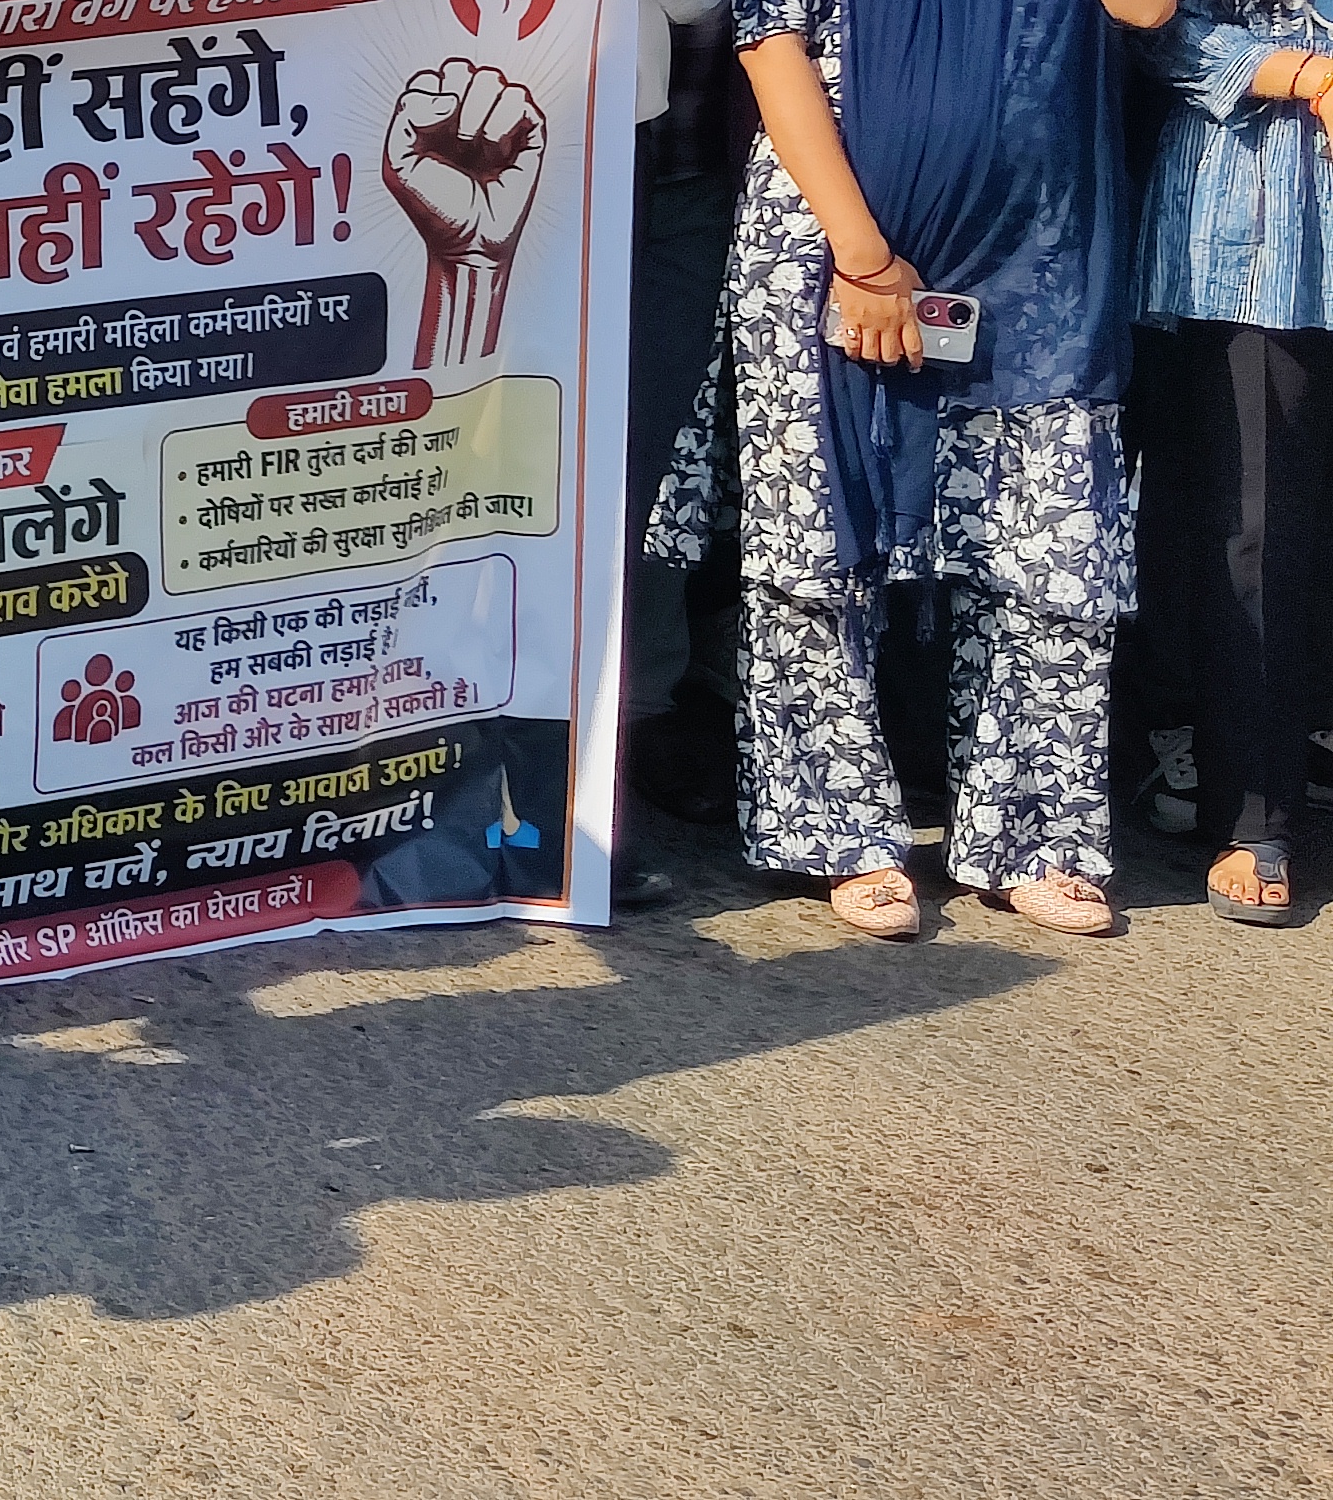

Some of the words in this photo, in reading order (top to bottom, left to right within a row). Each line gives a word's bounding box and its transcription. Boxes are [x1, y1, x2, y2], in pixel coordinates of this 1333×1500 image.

[72, 29, 309, 145] सहेंगे,
[132, 142, 352, 265] रहेंगे!
[28, 315, 97, 360] हमारी
[102, 310, 181, 348] महिला
[188, 290, 314, 338] कर्मचारियों
[317, 295, 351, 322] पर
[45, 366, 124, 405] हमला
[130, 355, 192, 392] किया
[197, 352, 254, 384] गया।
[285, 388, 353, 431] हमारी
[359, 384, 409, 418] मांग
[196, 449, 253, 486] हमारी
[261, 449, 301, 477] FIR
[307, 441, 346, 477] तुरंत
[352, 432, 386, 464] दर्ज
[390, 429, 417, 457] की
[197, 493, 264, 529] दोषियों
[268, 495, 295, 516] पर
[299, 488, 347, 513] सख्त
[199, 531, 297, 571] कर्मचारियों
[302, 527, 328, 555] की
[333, 525, 386, 558] सुरक्षा
[456, 492, 479, 519] की
[484, 494, 533, 519] जाए।
[48, 561, 131, 612] करेंगे
[174, 626, 207, 652] यह
[212, 611, 268, 646] किसी
[272, 610, 310, 637] एक
[314, 598, 345, 628] की
[350, 587, 402, 626] लड़ाई
[210, 657, 242, 685] हम
[247, 640, 313, 675] सबकी
[318, 629, 377, 668] लड़ाई
[131, 741, 175, 767] कल
[180, 723, 238, 760] किसी
[243, 716, 284, 749] और
[288, 712, 312, 740] के
[316, 710, 362, 736] साथ
[383, 680, 448, 719] सकती
[453, 677, 479, 708] है।
[174, 697, 221, 725] आज
[227, 684, 259, 715] की
[266, 680, 325, 709] घटना
[330, 665, 379, 703] हमारे
[39, 802, 165, 847] अधिकार
[173, 788, 207, 824] के
[214, 779, 272, 818] लिए
[279, 764, 371, 806] आवाज
[84, 838, 168, 889] चलें,
[186, 829, 293, 870] न्याय
[300, 789, 435, 853] दिलाएं!
[35, 924, 76, 958] SP
[169, 901, 201, 930] का
[206, 889, 261, 921] घेराव
[267, 874, 314, 910] करें।
